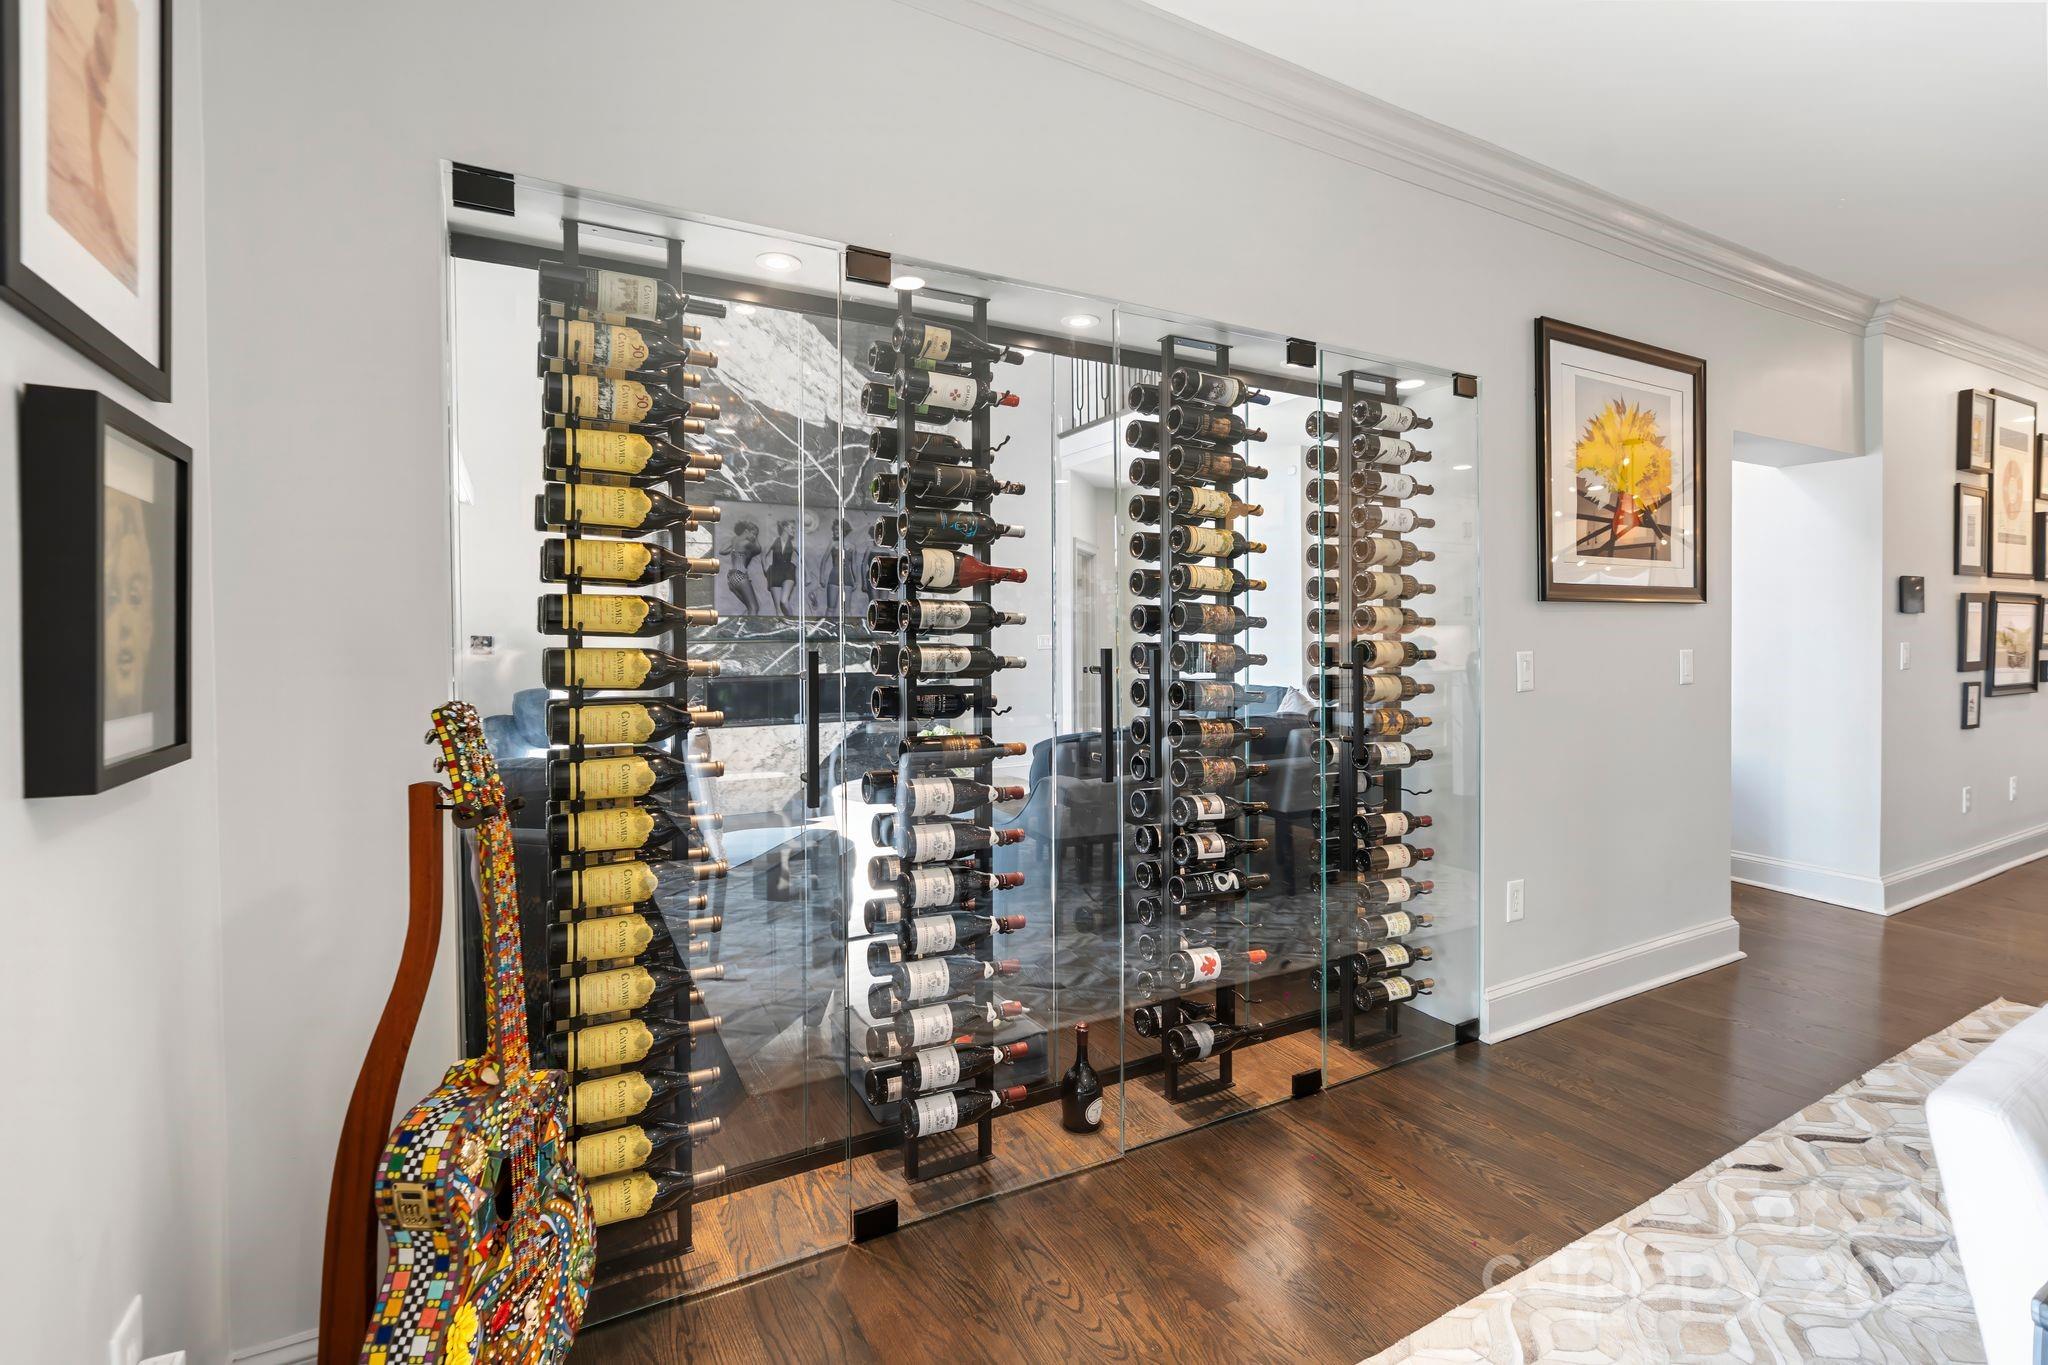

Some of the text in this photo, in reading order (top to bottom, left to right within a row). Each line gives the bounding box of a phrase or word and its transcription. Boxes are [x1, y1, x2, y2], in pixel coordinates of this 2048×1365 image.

[619, 333, 627, 367] CAYMUS
[632, 344, 645, 359] 50
[622, 385, 630, 419] CAYMUS
[636, 393, 648, 409] 50
[617, 435, 627, 464] CAYMUS
[617, 489, 626, 519] CAYMUS
[617, 542, 625, 571] CAYMUS
[615, 596, 623, 625] CAYMUS
[616, 651, 625, 682] CAYMUS
[621, 711, 630, 742] CAYMUS
[621, 764, 631, 795] CAYMUS
[619, 811, 628, 842] CAYMUS
[623, 869, 632, 900] CAYMUS
[618, 920, 628, 953] CAYMUS
[621, 973, 630, 1007] CAYMUS
[619, 1027, 629, 1060] CAYMUS
[617, 1080, 626, 1114] CAYMUS
[617, 1135, 626, 1169] CAYMUS
[622, 1178, 632, 1214] CAYMUS
